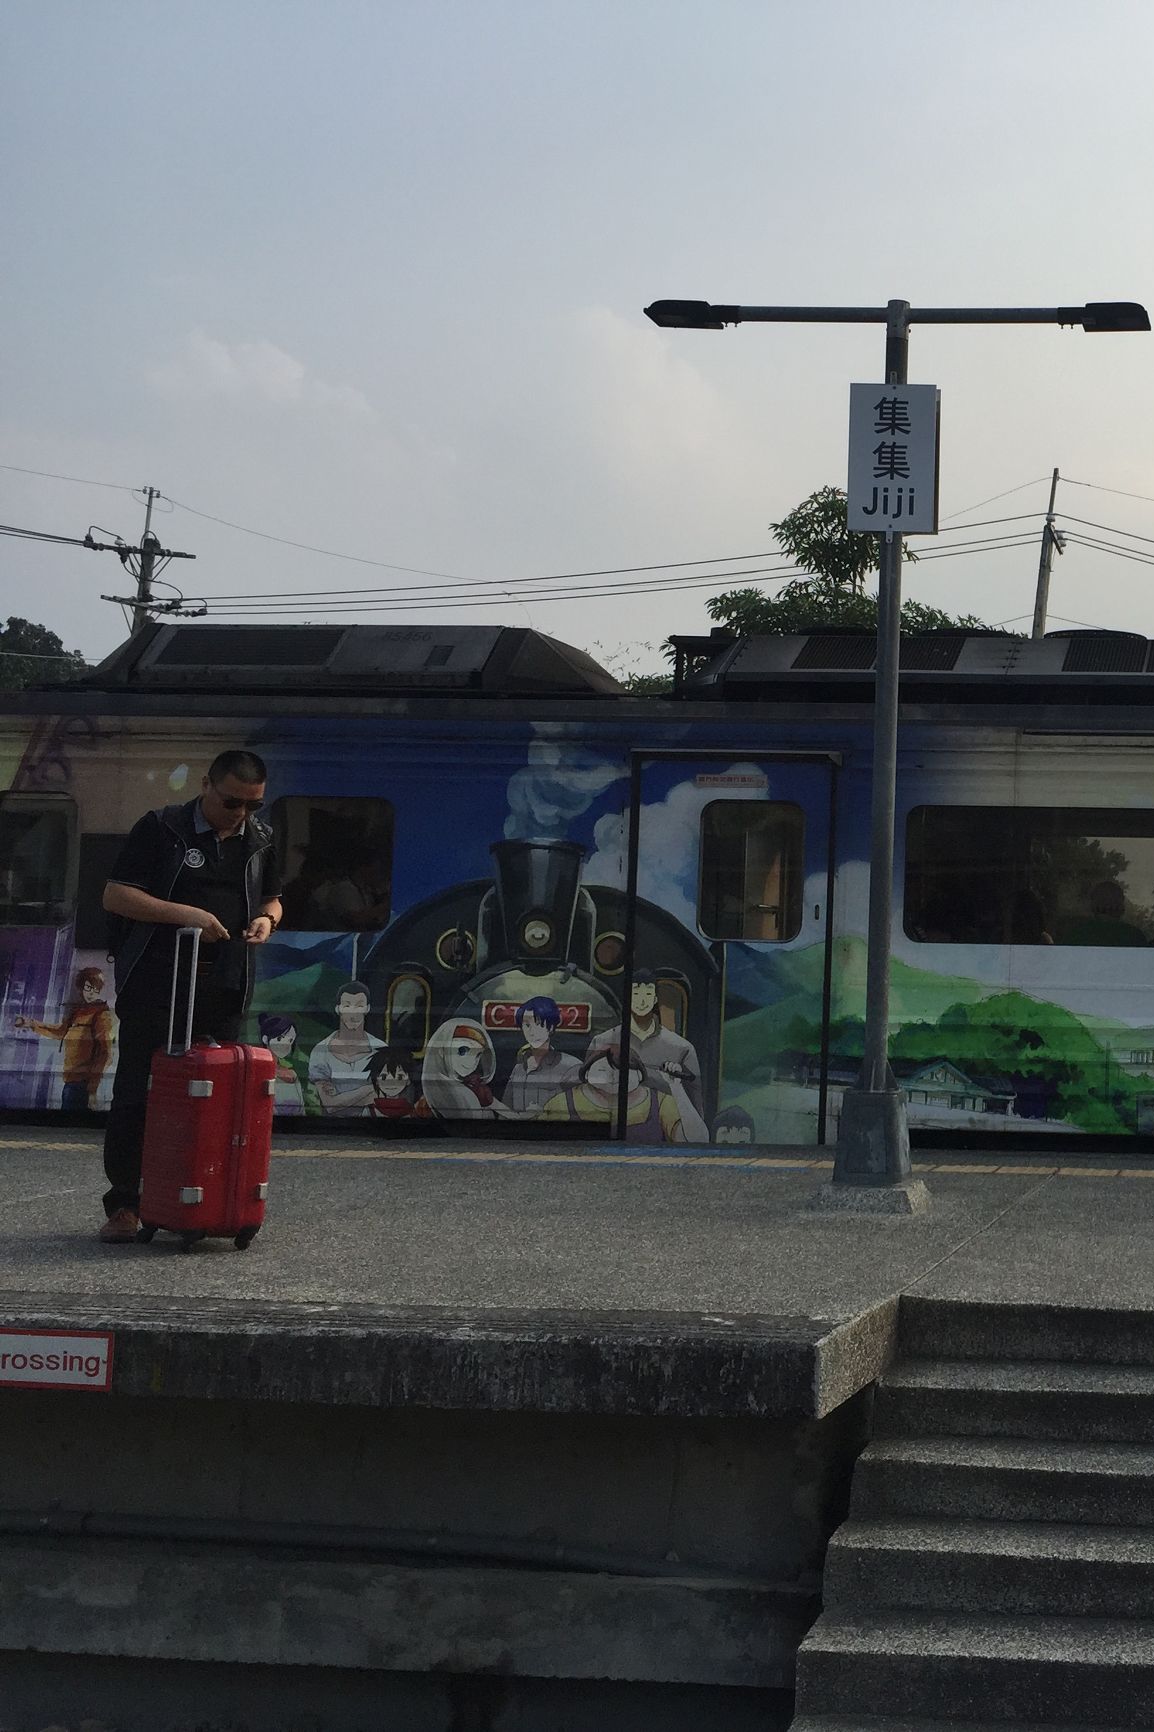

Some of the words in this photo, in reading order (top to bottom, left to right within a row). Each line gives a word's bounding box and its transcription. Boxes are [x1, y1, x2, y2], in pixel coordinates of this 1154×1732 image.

[873, 396, 911, 480] 集集
[862, 486, 915, 519] Jiji
[0, 1350, 101, 1378] rossing
